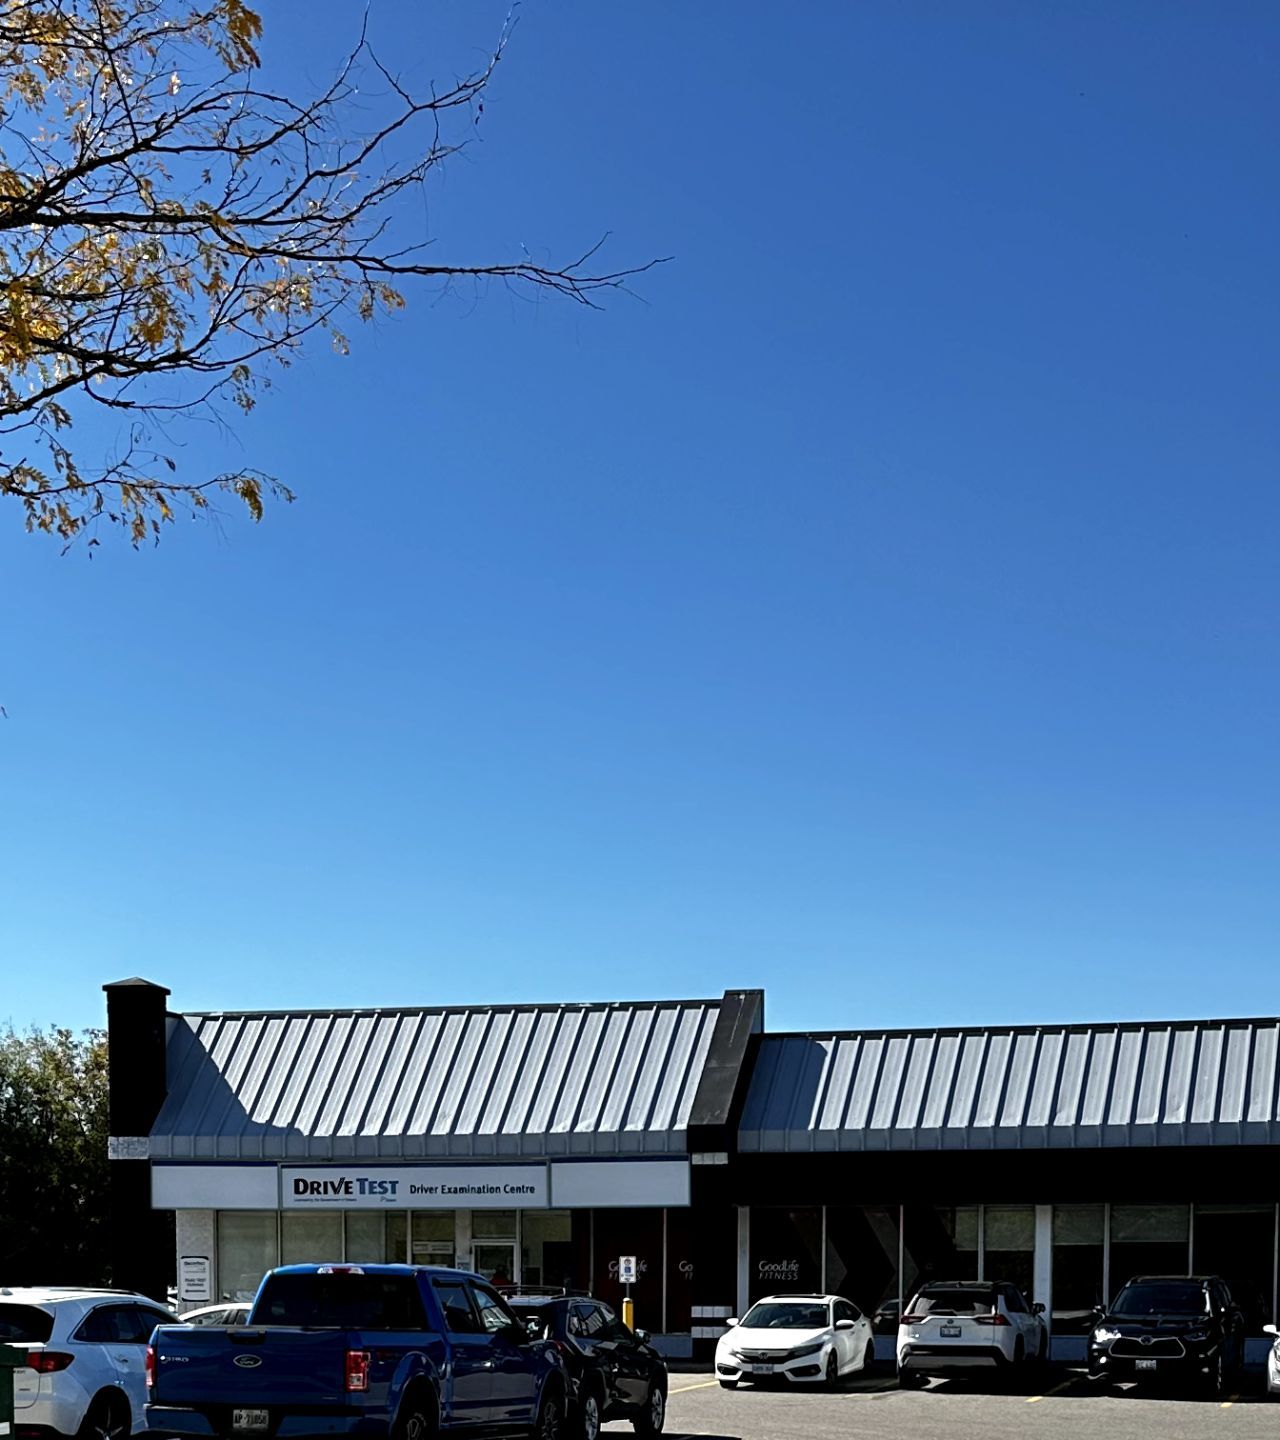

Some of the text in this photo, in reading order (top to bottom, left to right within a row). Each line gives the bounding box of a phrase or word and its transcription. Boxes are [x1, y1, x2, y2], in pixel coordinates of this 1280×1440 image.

[410, 1184, 438, 1194] Driver
[441, 1184, 500, 1194] Examination
[503, 1184, 535, 1194] Centre
[758, 1260, 799, 1271] GoodLife
[758, 1272, 799, 1280] FITNESS
